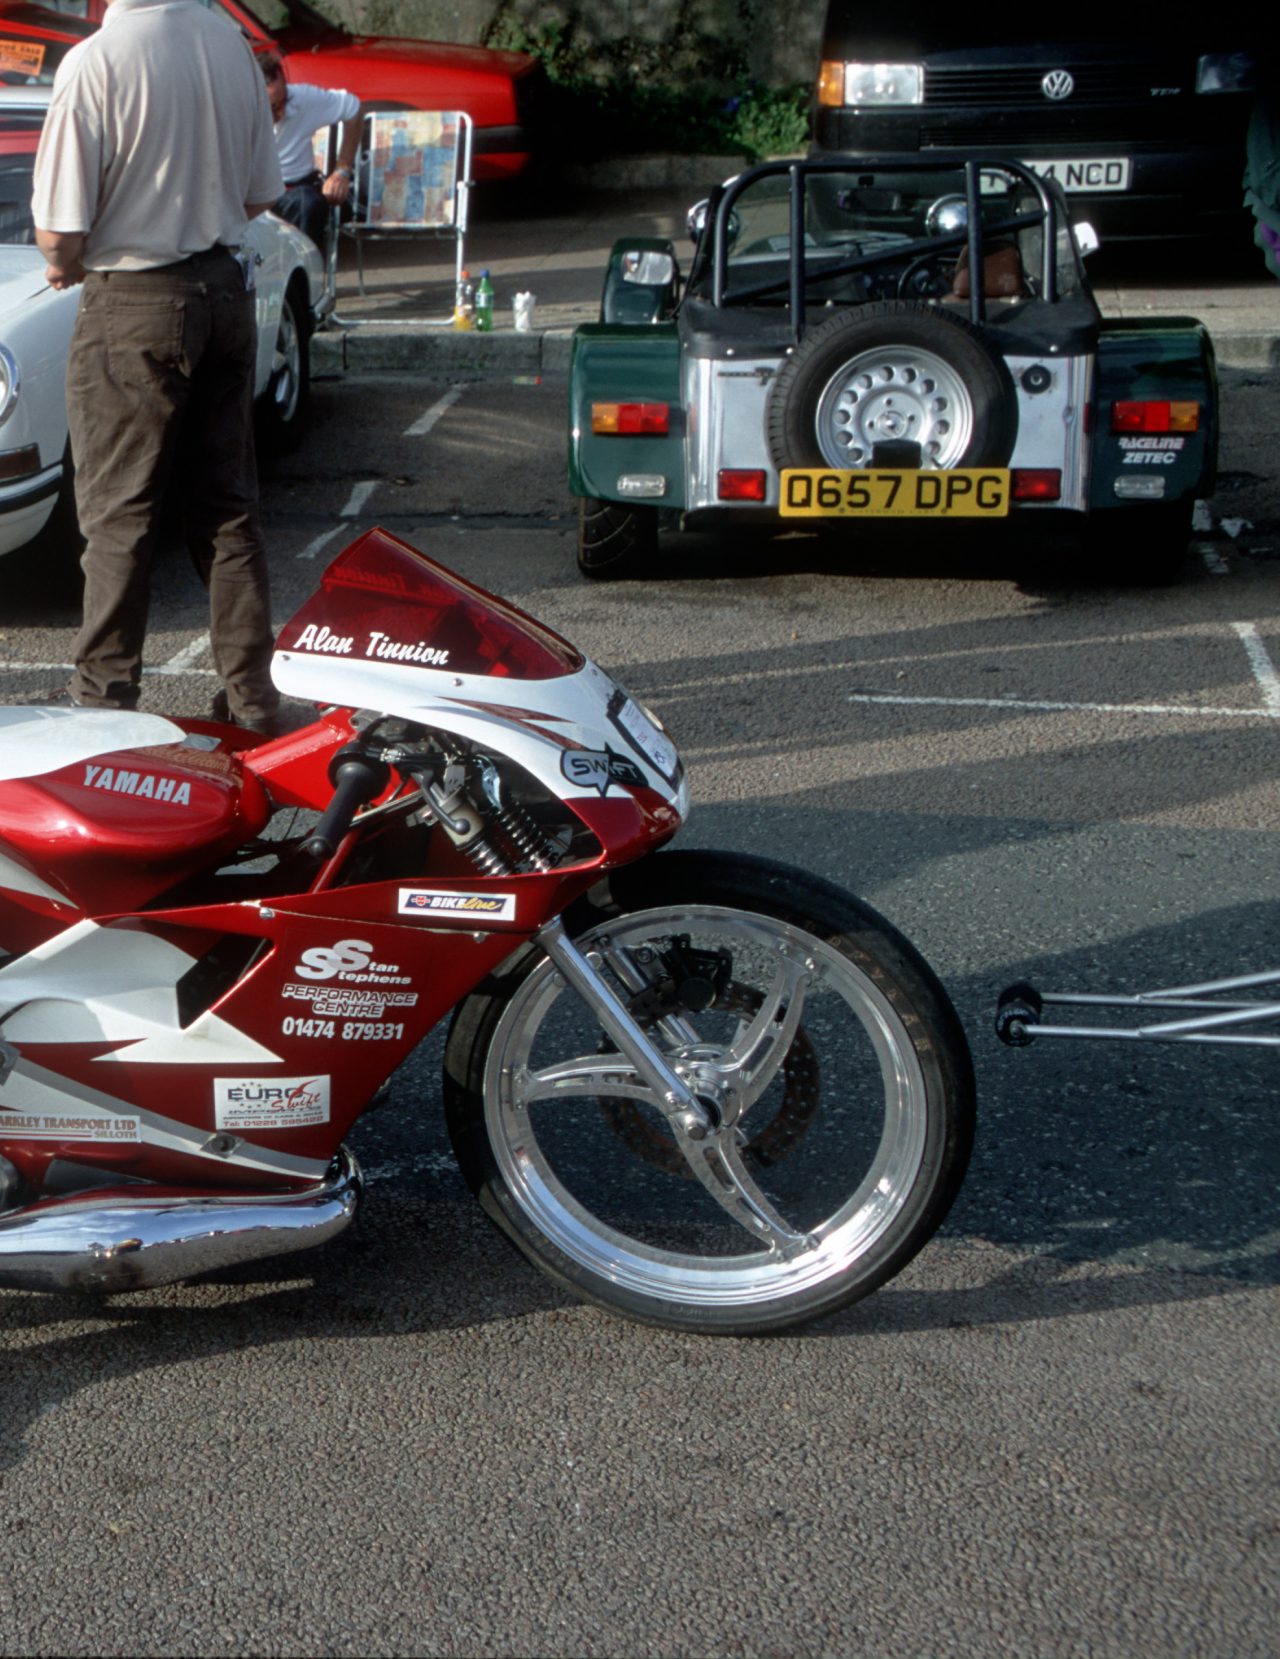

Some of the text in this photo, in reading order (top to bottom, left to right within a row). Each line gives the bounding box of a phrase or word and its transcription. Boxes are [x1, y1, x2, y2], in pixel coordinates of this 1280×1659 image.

[1065, 162, 1123, 186] NCD
[1118, 437, 1184, 450] RACELINE
[1122, 451, 1177, 464] ZETEC
[787, 475, 1003, 509] Q657 DPG
[293, 624, 450, 665] Alan Tinnion
[83, 764, 191, 806] YAMAHA
[282, 983, 418, 1006] PERFORMANCE
[312, 1000, 385, 1018] CENTRE
[282, 1017, 404, 1040] 01474 879331
[228, 1088, 305, 1100] EURO
[44, 1117, 111, 1129] TRANSPORT
[114, 1119, 136, 1130] LTD
[94, 1130, 137, 1139] SILLOTH
